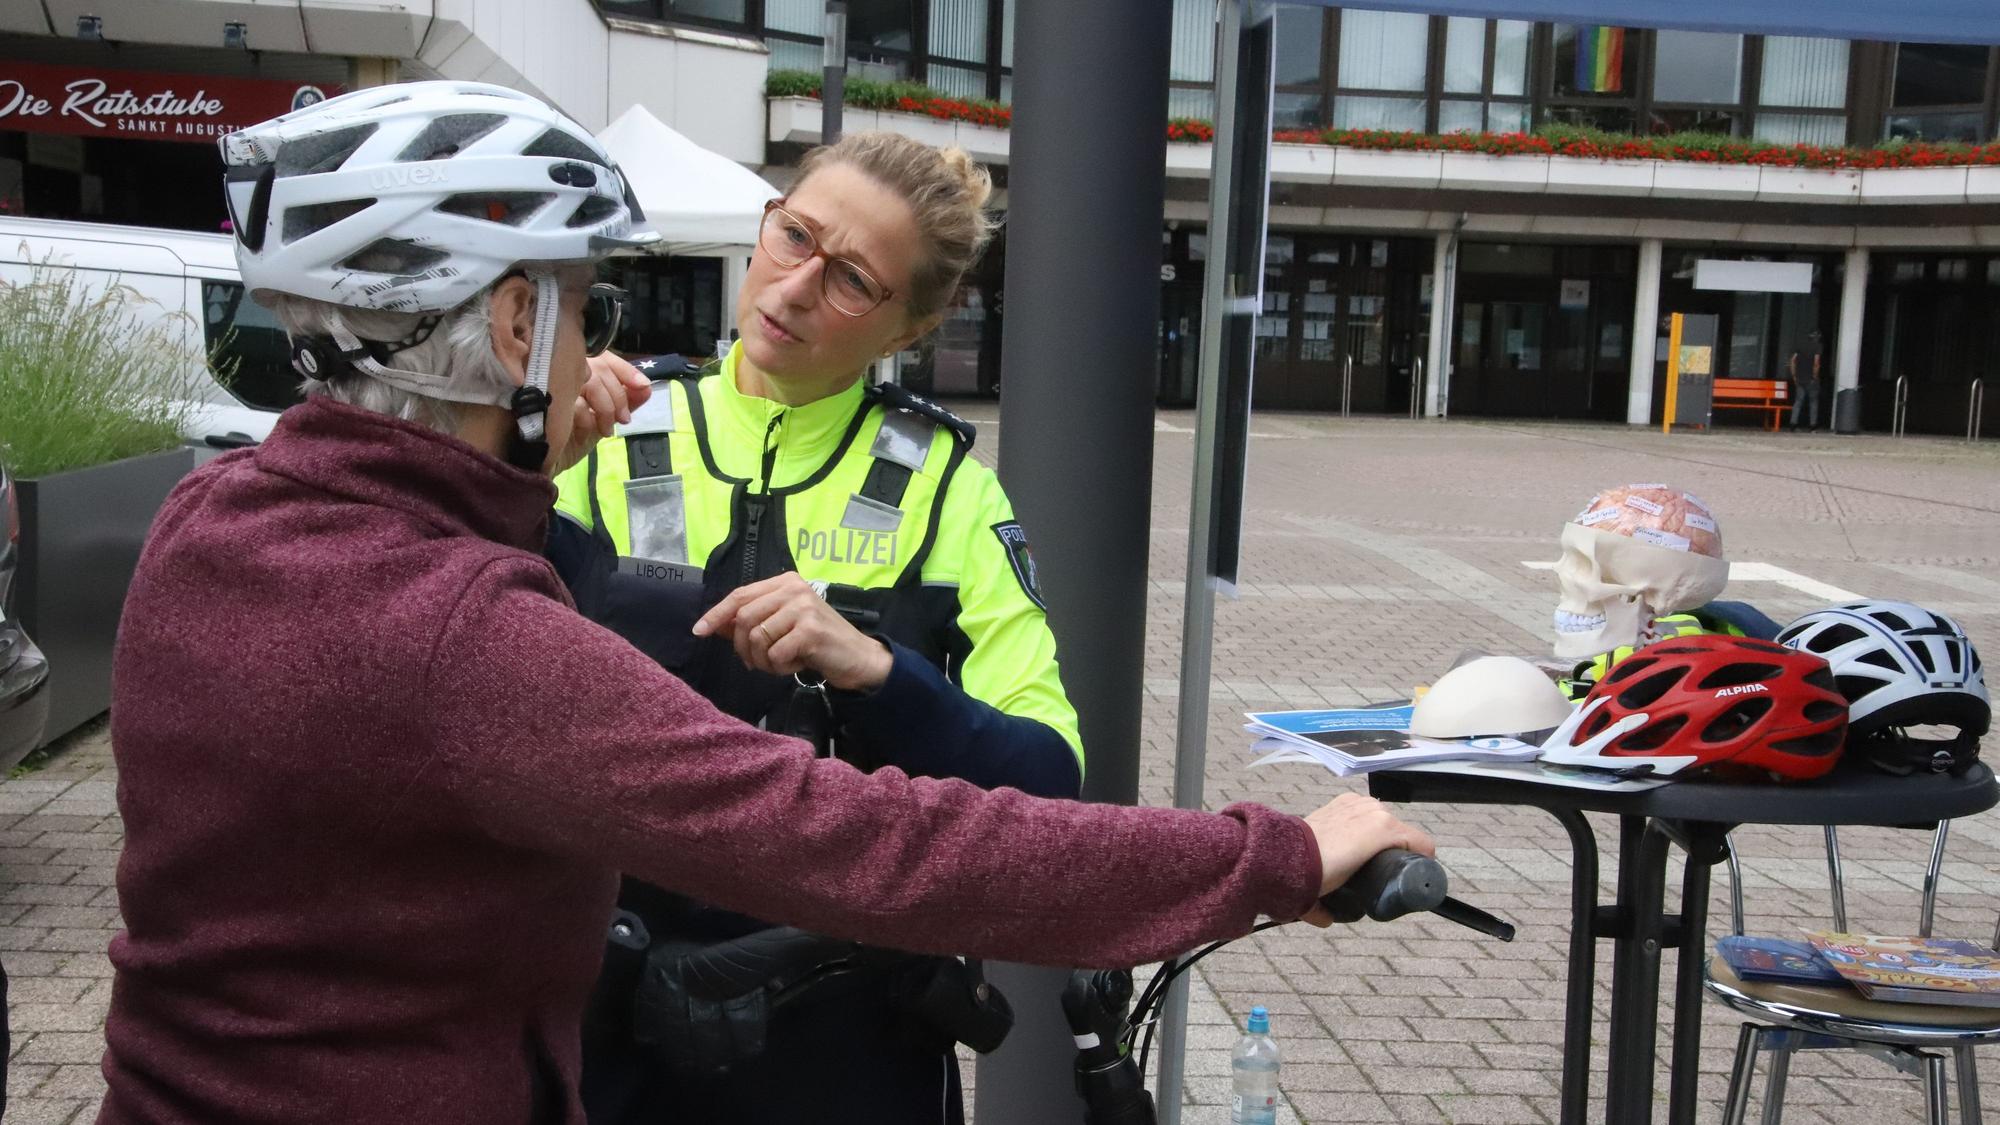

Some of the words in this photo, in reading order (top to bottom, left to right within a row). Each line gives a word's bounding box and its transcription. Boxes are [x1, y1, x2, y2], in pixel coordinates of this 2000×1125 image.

[61, 79, 224, 127] Ratsstube
[118, 119, 166, 132] SANKT
[176, 123, 246, 135] AUGUST
[370, 165, 449, 191] uvex
[795, 528, 897, 566] POLIZEI
[636, 562, 684, 581] LIBOTH
[1714, 683, 1769, 698] ALPINA
